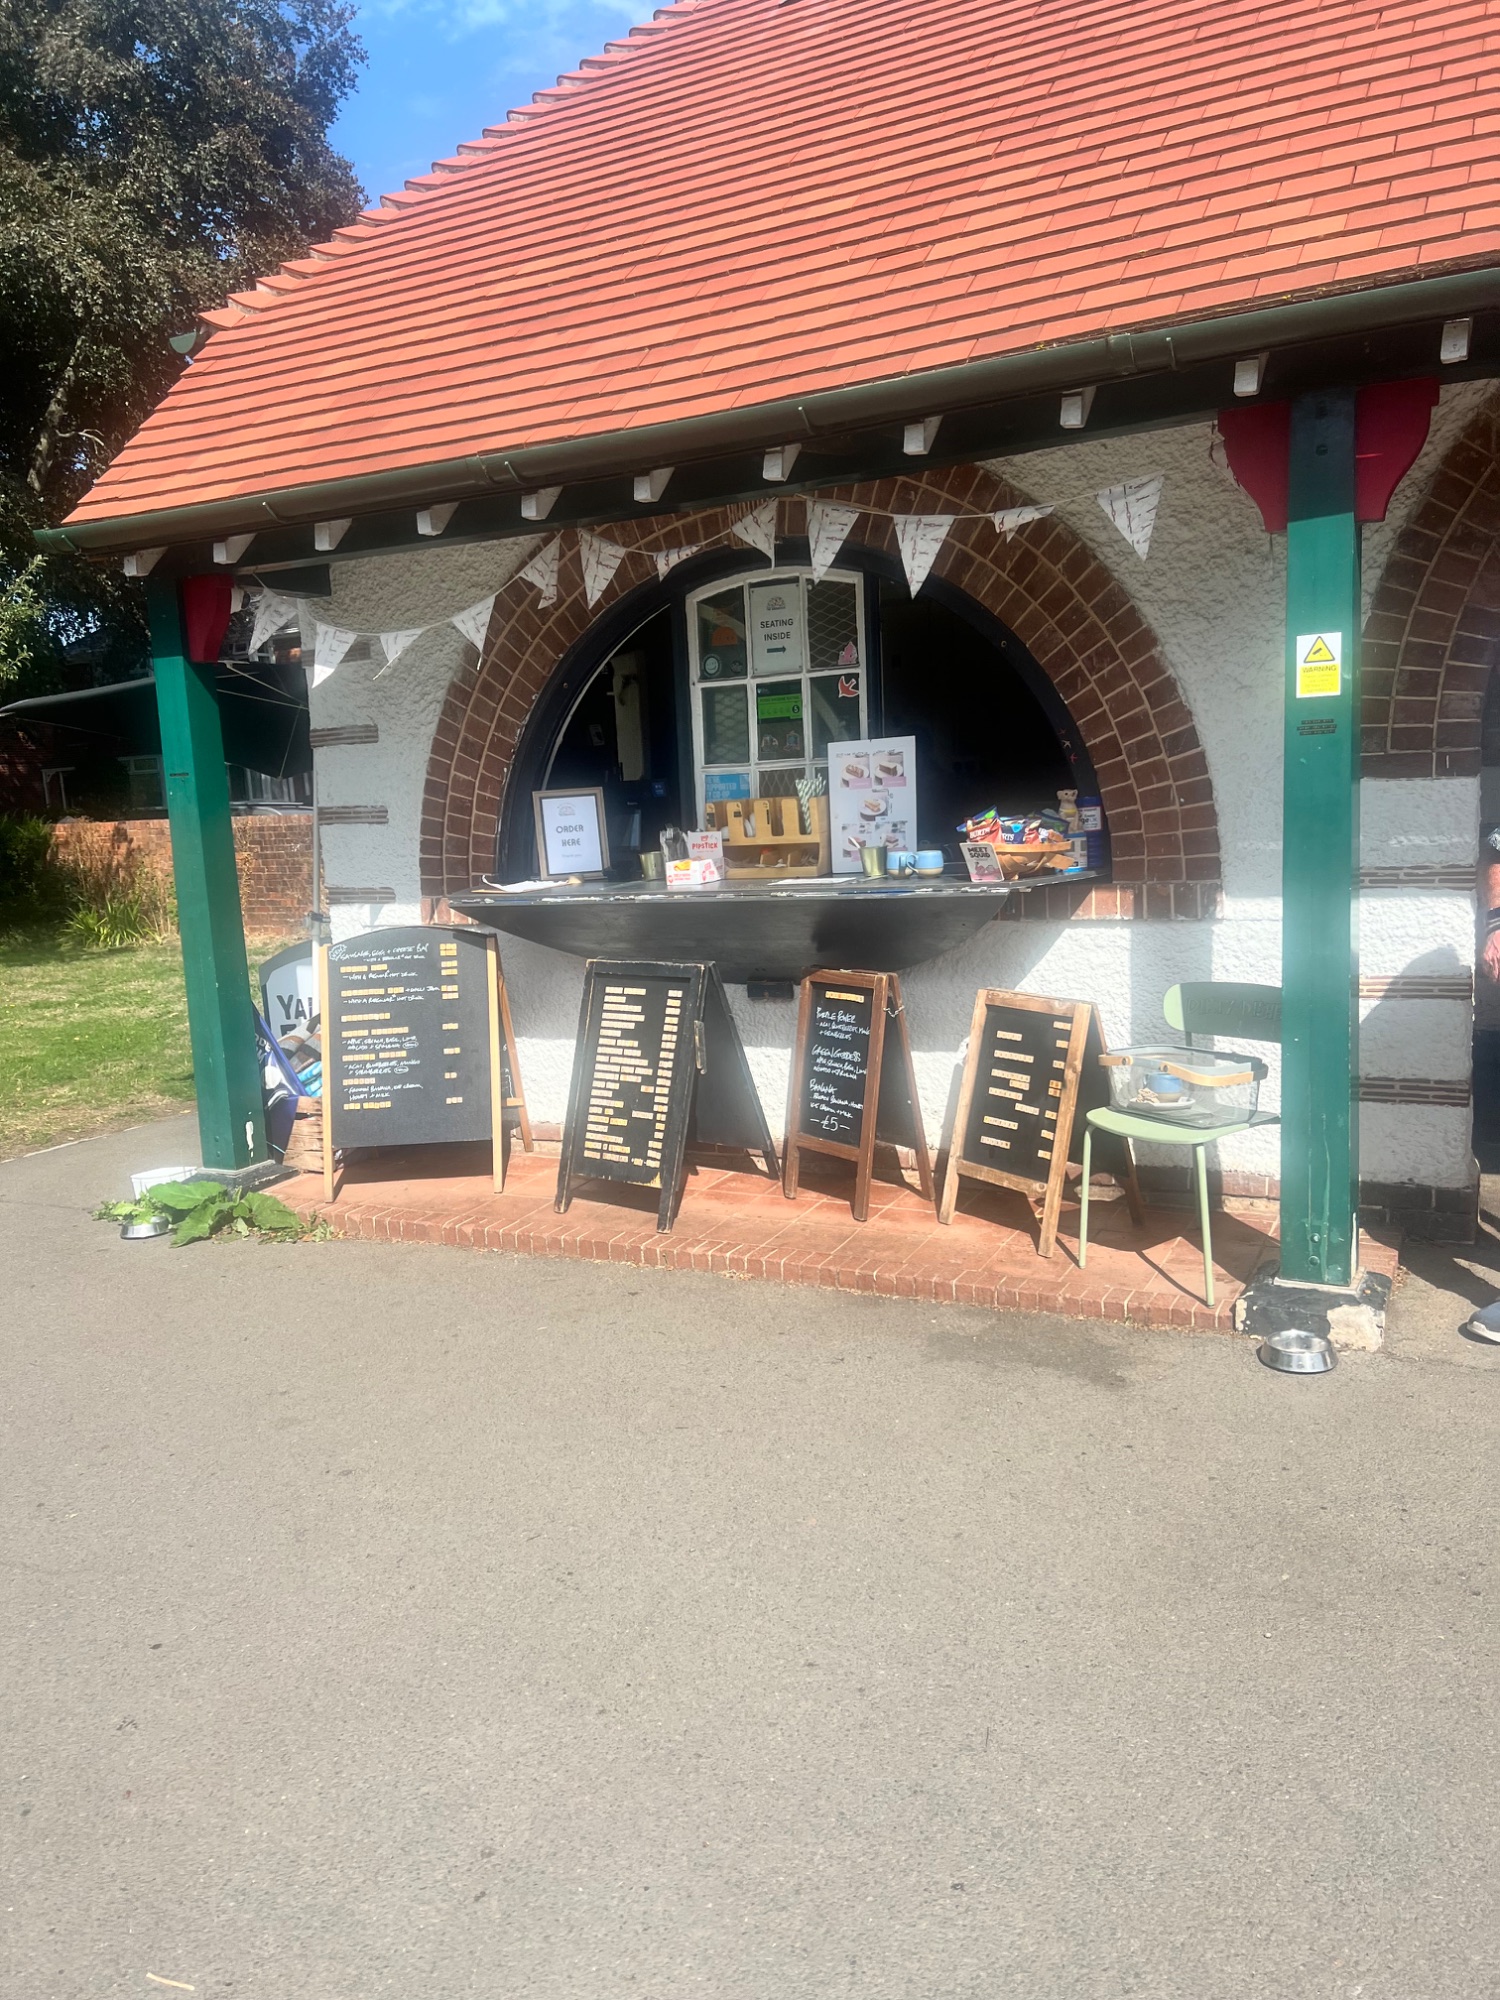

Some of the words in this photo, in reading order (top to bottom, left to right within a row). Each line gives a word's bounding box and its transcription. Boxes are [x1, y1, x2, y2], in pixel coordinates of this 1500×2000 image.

[760, 618, 794, 629] SEATING
[764, 631, 791, 641] INSIDE
[1302, 664, 1337, 673] WARNING
[556, 824, 584, 833] ORDER
[561, 838, 582, 847] HERE
[276, 994, 313, 1020] YA
[1185, 999, 1235, 1016] DIRTY
[837, 1010, 856, 1023] POWER
[833, 1048, 862, 1062] GODDESS
[820, 1115, 838, 1131] £5
